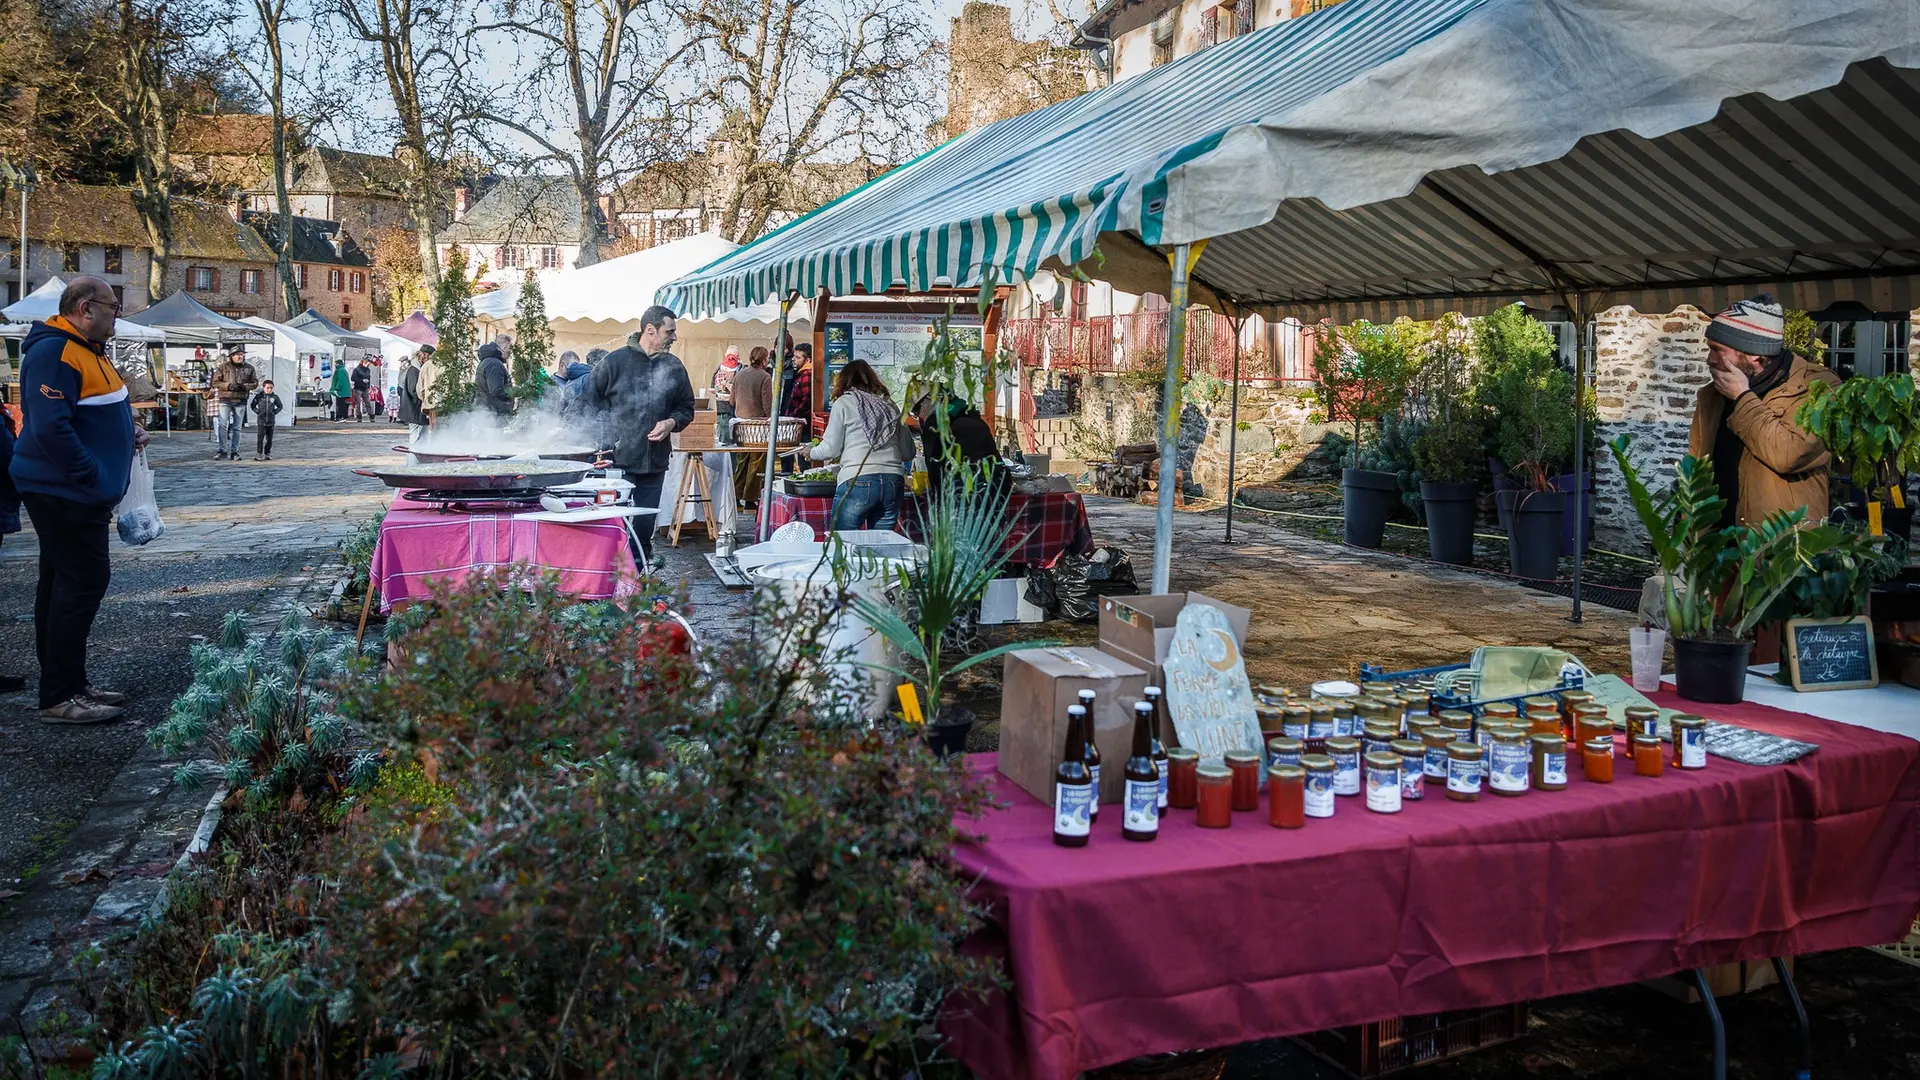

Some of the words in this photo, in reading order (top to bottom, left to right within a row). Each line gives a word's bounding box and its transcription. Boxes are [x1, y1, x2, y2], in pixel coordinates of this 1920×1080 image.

[1176, 638, 1197, 658] LA
[1177, 703, 1196, 721] LA
[1193, 720, 1242, 760] LUNE
